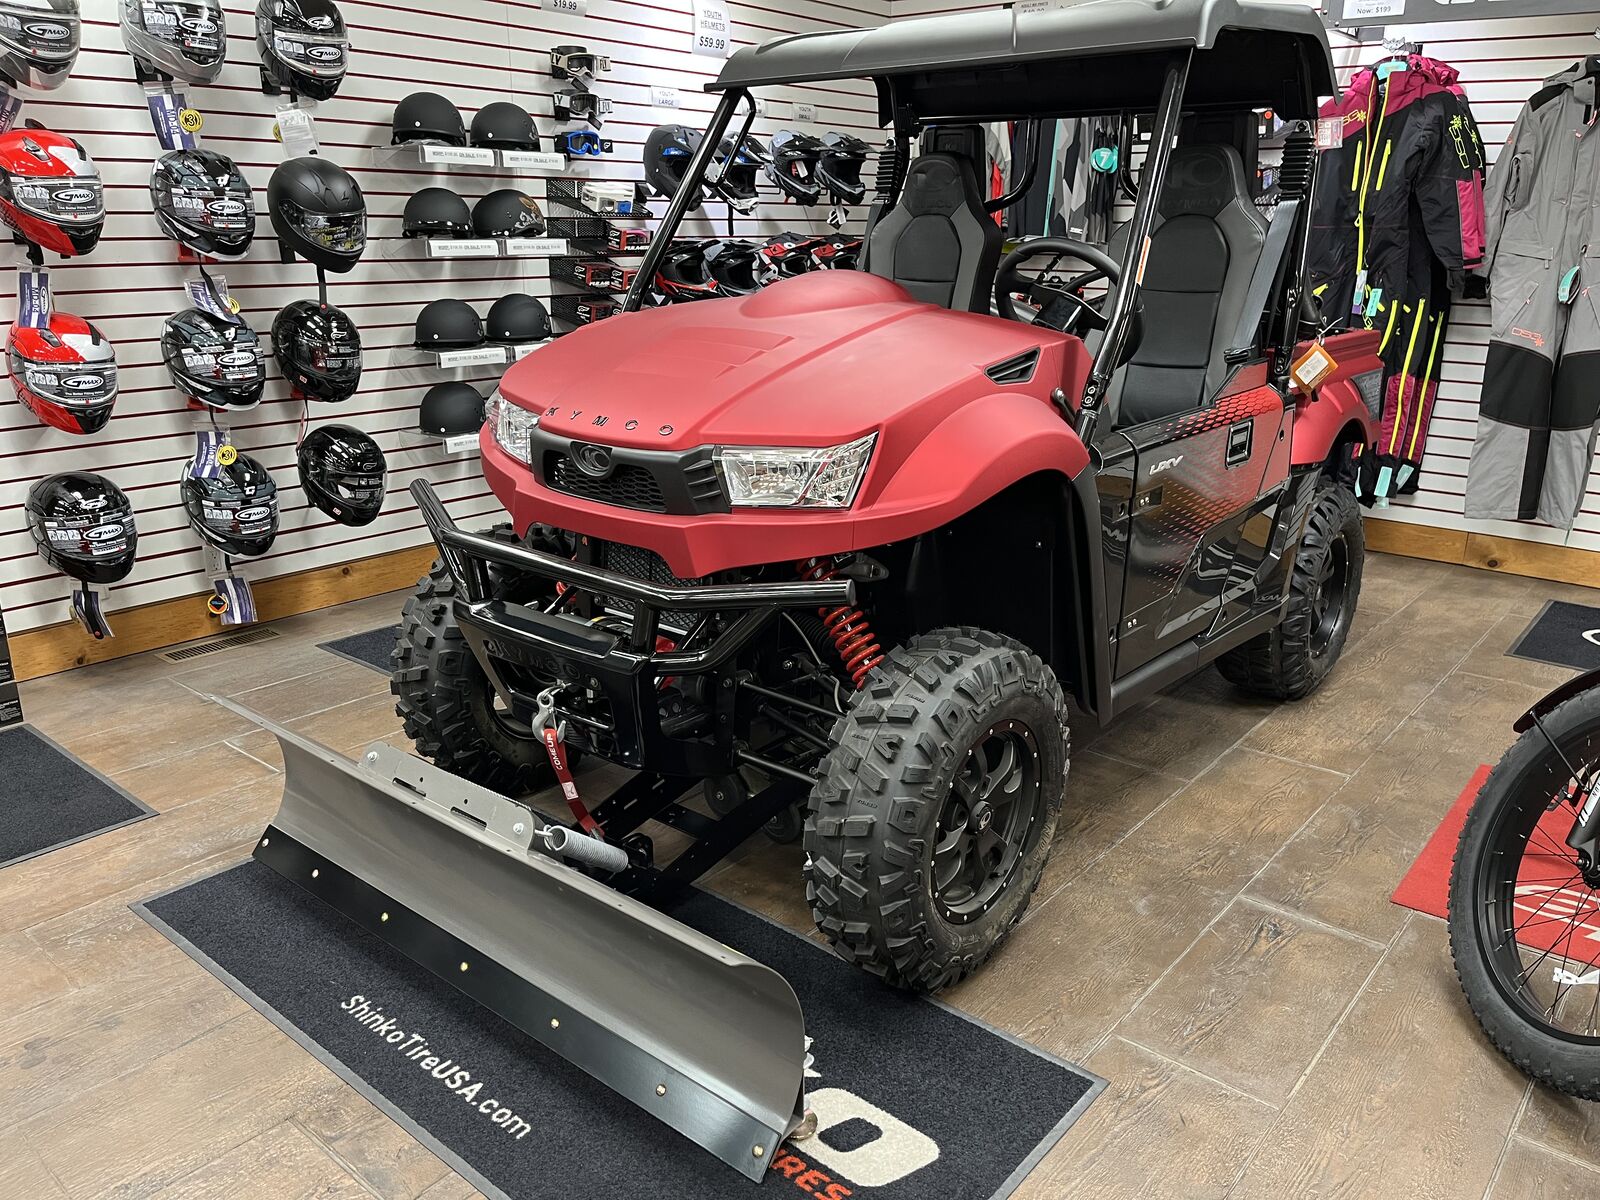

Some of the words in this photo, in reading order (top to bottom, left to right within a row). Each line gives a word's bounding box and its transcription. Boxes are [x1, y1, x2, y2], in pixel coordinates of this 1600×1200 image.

[703, 10, 722, 20] YOUTH
[1375, 5, 1391, 13] $199
[26, 23, 70, 39] GMAX
[700, 20, 726, 31] HELMETS
[699, 36, 725, 49] $59.99
[307, 47, 341, 60] GMAX
[599, 58, 608, 70] FLY
[602, 101, 611, 111] FLY
[658, 99, 674, 107] LARGE
[53, 189, 95, 203] GMAX
[207, 200, 246, 213] GMAX
[218, 352, 255, 365] GMAX
[61, 375, 104, 389] GMAX
[545, 407, 674, 437] KYMCO
[235, 506, 270, 521] GMAX
[83, 524, 124, 541] GMAX
[545, 732, 564, 771] COMEUP
[341, 994, 532, 1140] ShinkoTireUSA.com
